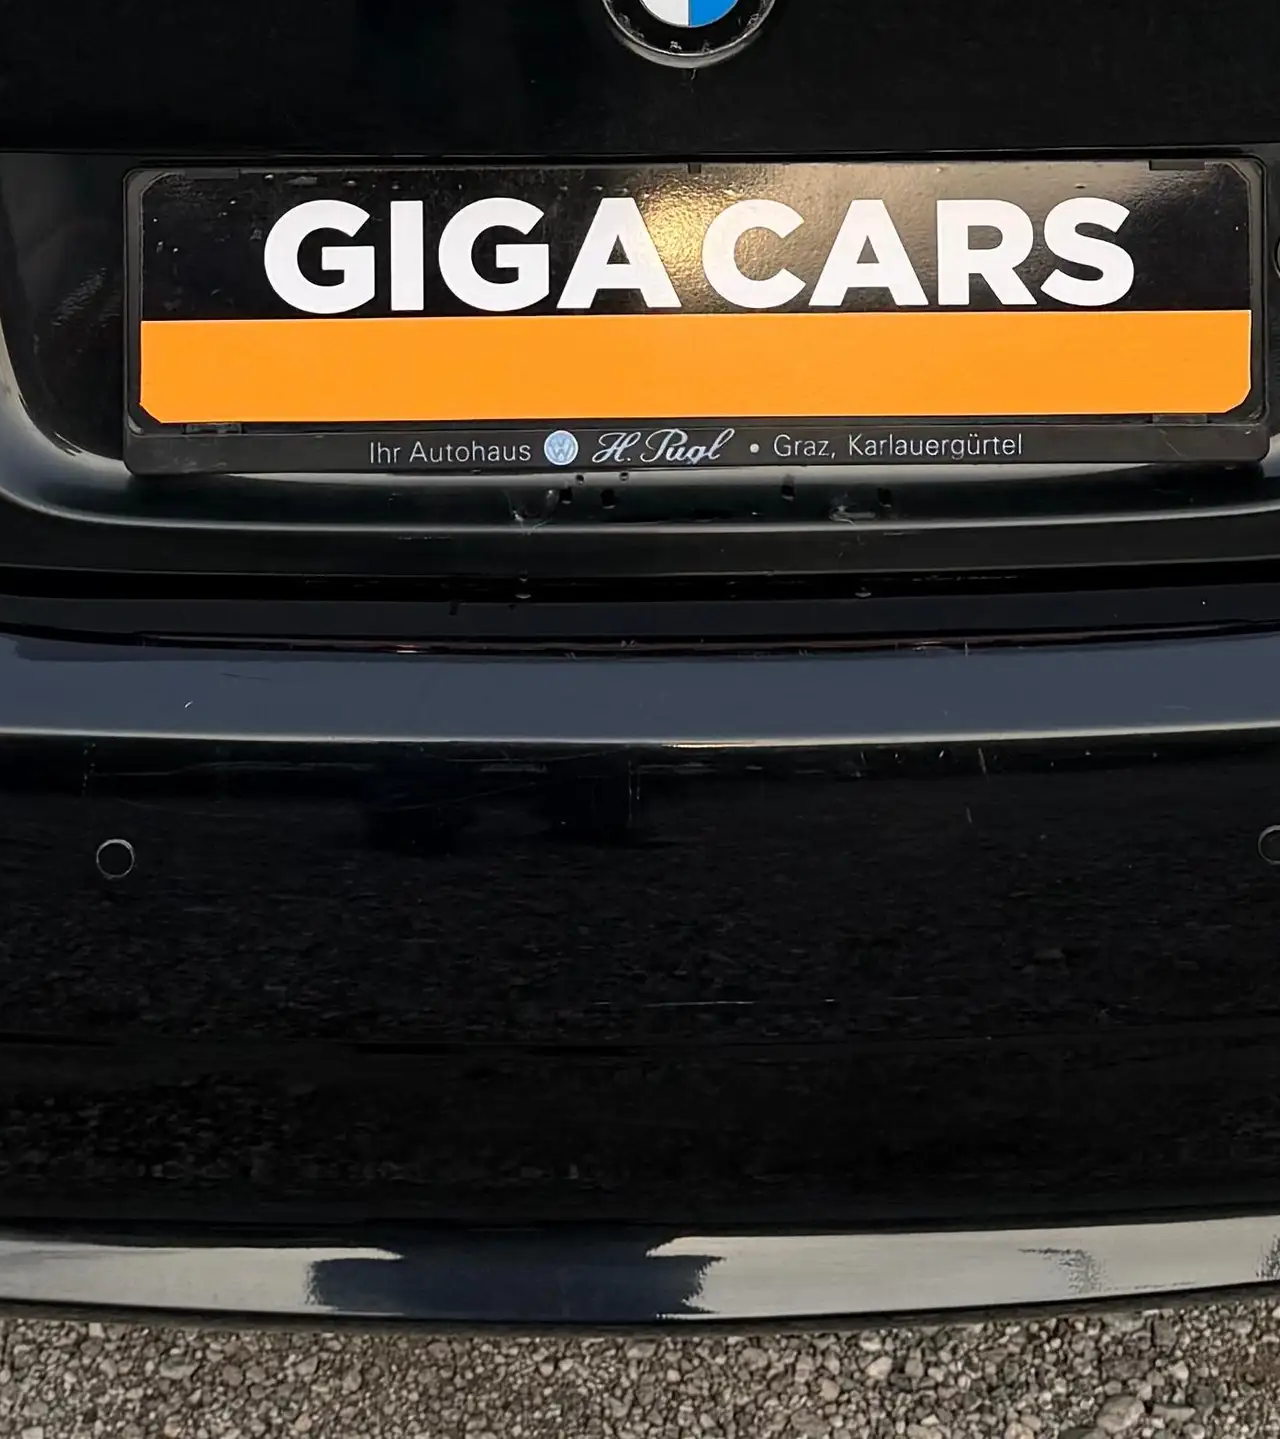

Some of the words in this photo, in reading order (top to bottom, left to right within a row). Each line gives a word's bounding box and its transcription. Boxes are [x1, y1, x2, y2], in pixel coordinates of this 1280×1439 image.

[263, 198, 682, 315] GIGA
[699, 198, 1135, 310] CARS
[370, 442, 401, 464] Ihr
[409, 440, 531, 463] Autohaus
[773, 434, 836, 459] Graz,
[848, 433, 1023, 460] Karlauergürtel
